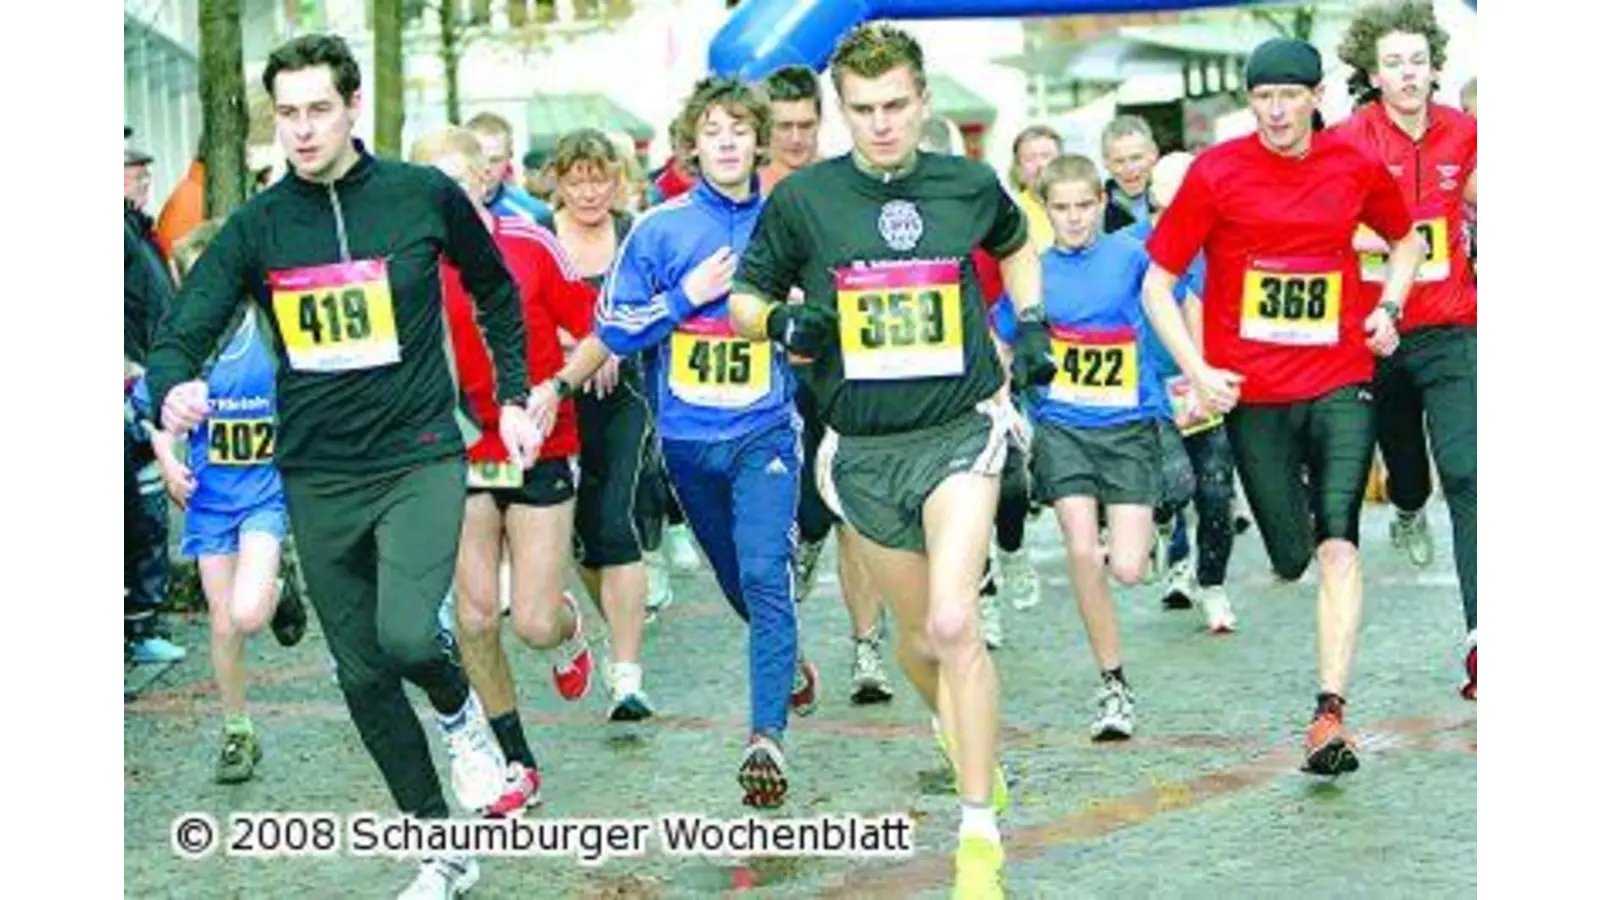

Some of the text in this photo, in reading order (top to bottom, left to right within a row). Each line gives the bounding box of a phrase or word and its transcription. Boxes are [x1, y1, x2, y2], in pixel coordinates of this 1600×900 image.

[299, 289, 371, 344] 419
[857, 290, 944, 348] 359
[1259, 277, 1328, 319] 368
[688, 340, 750, 384] 415
[1063, 347, 1123, 386] 422
[211, 422, 274, 460] 402
